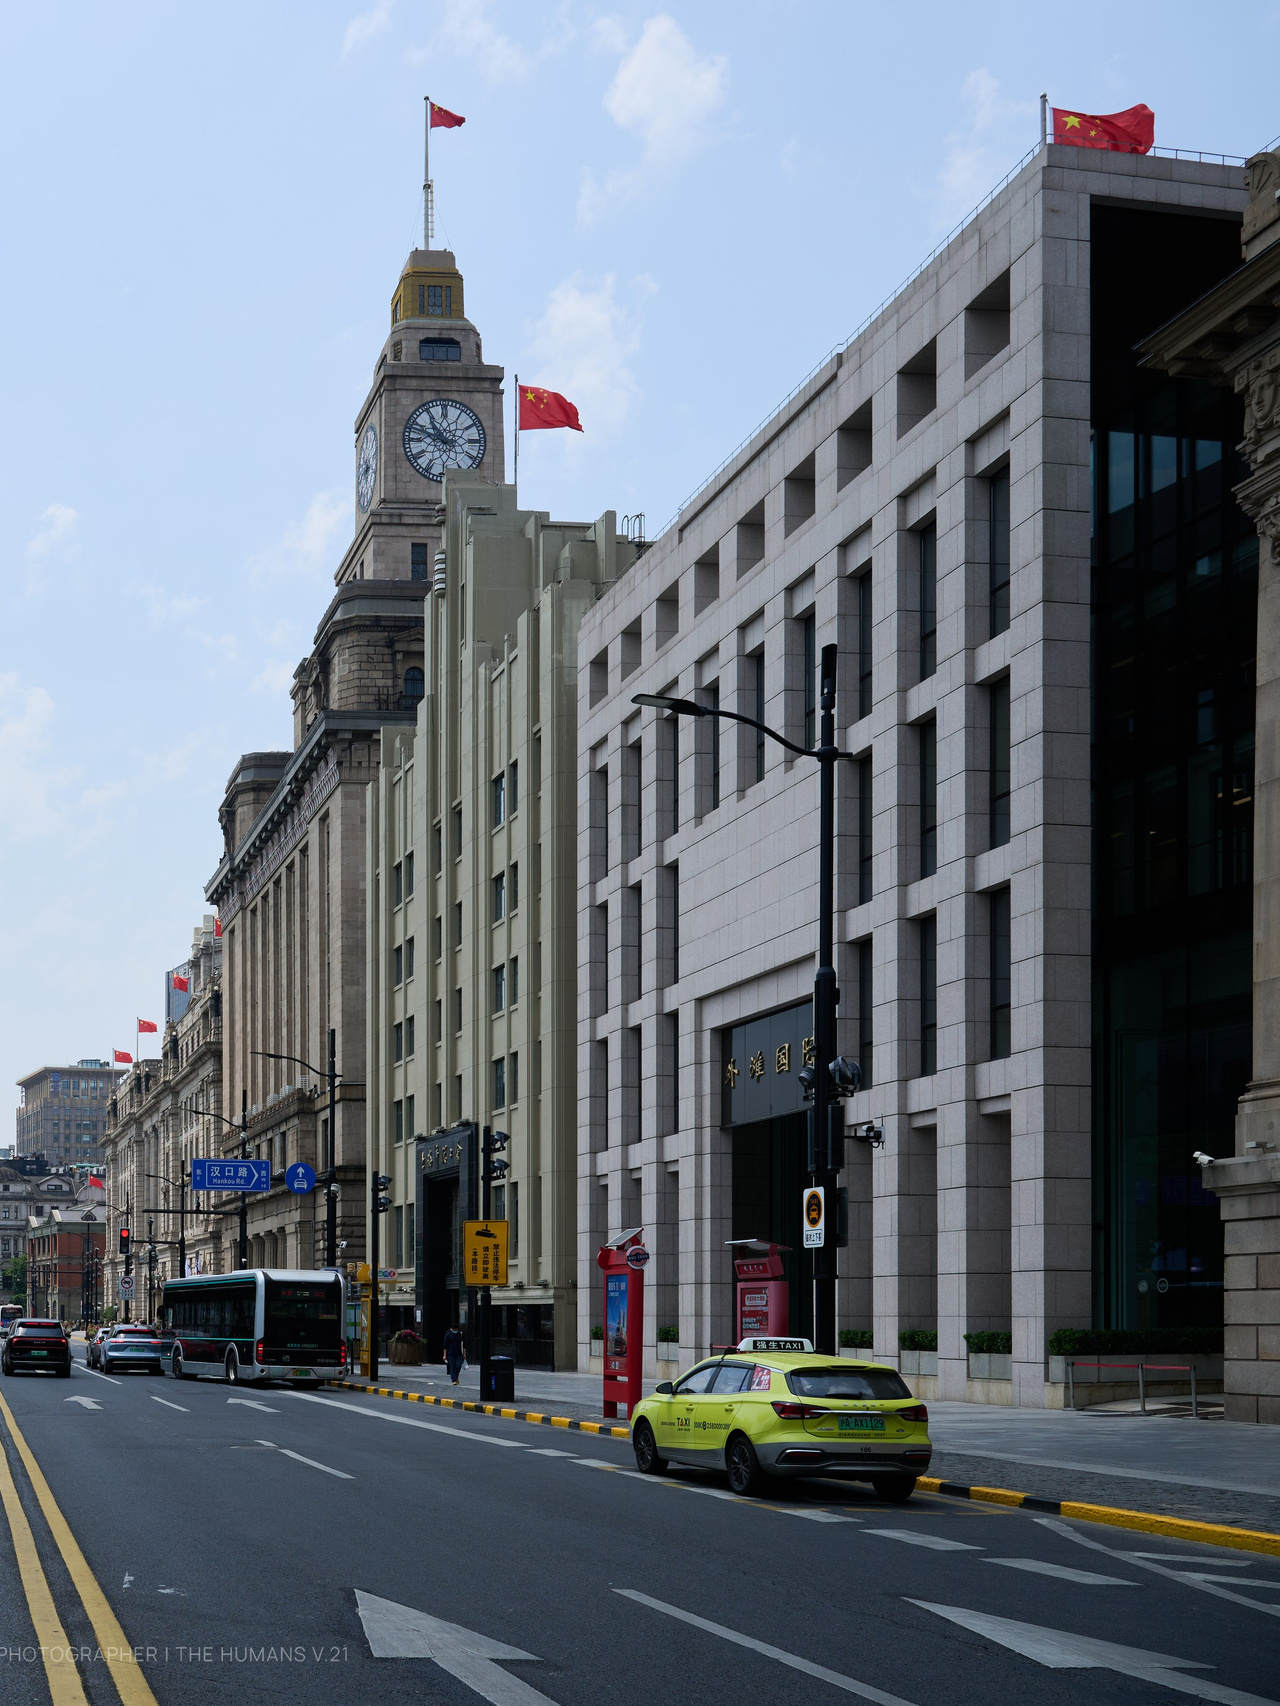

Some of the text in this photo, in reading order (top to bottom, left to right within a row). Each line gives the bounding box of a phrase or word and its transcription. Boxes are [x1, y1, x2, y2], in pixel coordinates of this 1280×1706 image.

[196, 1168, 202, 1176] 东
[210, 1166, 248, 1177] 汉口路
[482, 1246, 490, 1280] 请立即驶离
[492, 1244, 500, 1281] 禁止违法停车
[676, 1417, 690, 1426] TAXI
